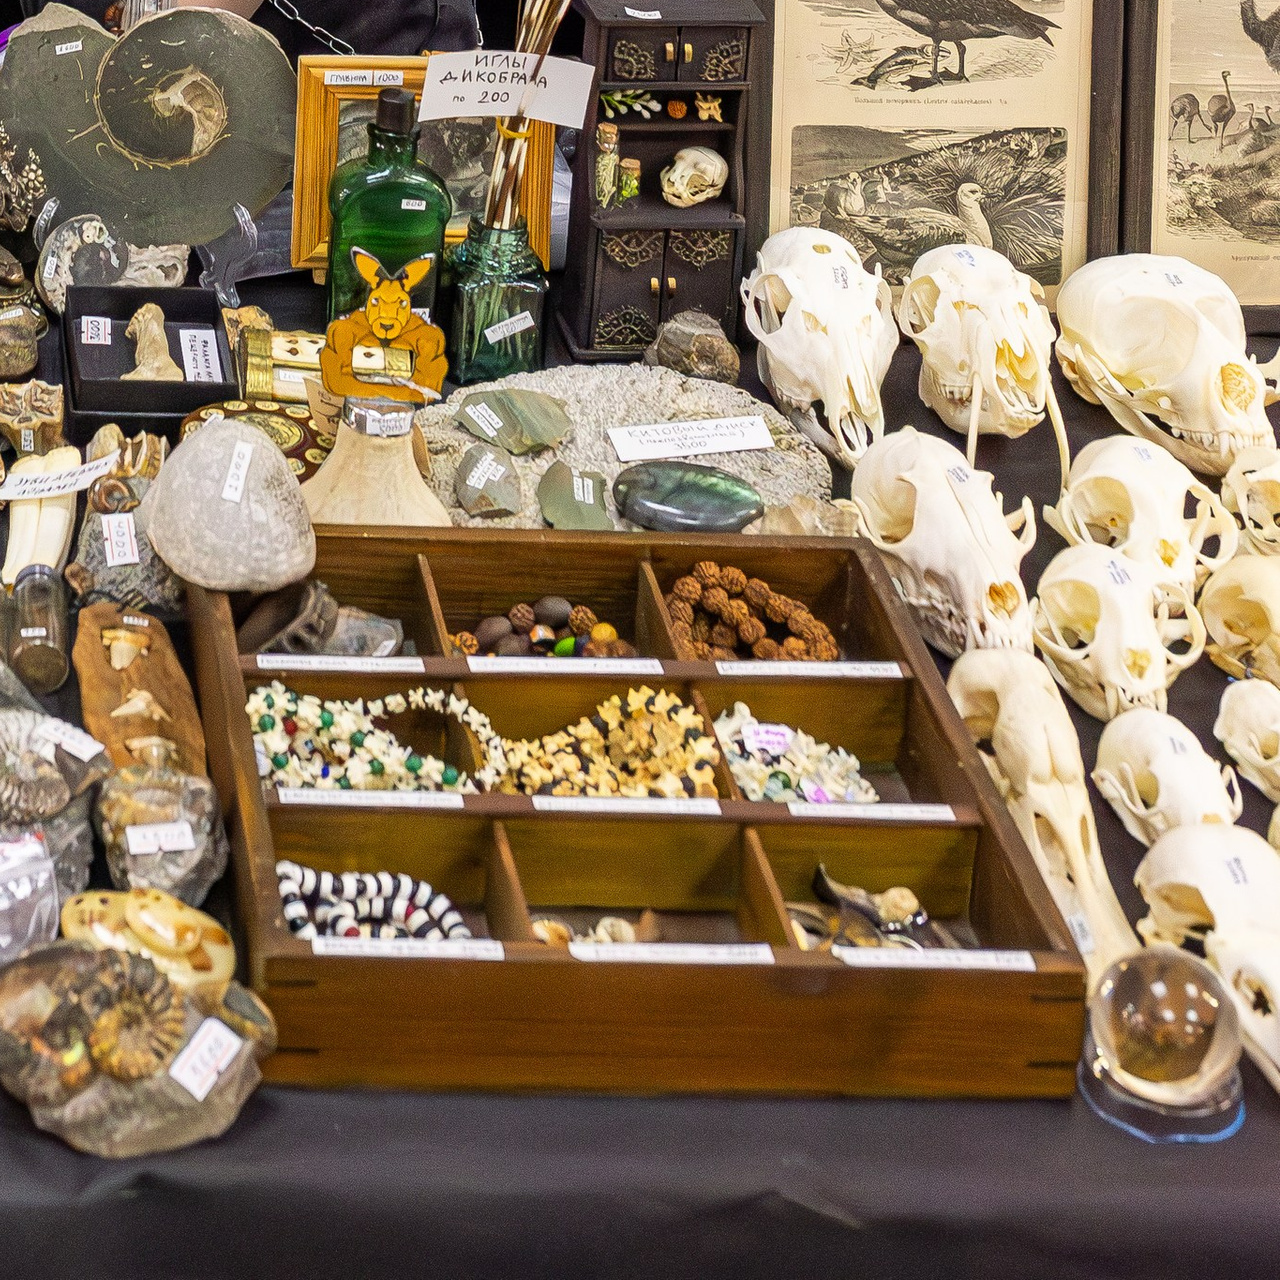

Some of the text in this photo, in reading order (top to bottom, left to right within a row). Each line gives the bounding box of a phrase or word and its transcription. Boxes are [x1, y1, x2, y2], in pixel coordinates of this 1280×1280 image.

[475, 54, 527, 70] ИГЛЫ
[453, 91, 510, 104] по 200
[627, 420, 756, 439] КИТОВЫЙ ДИСК
[673, 440, 708, 451] 3500
